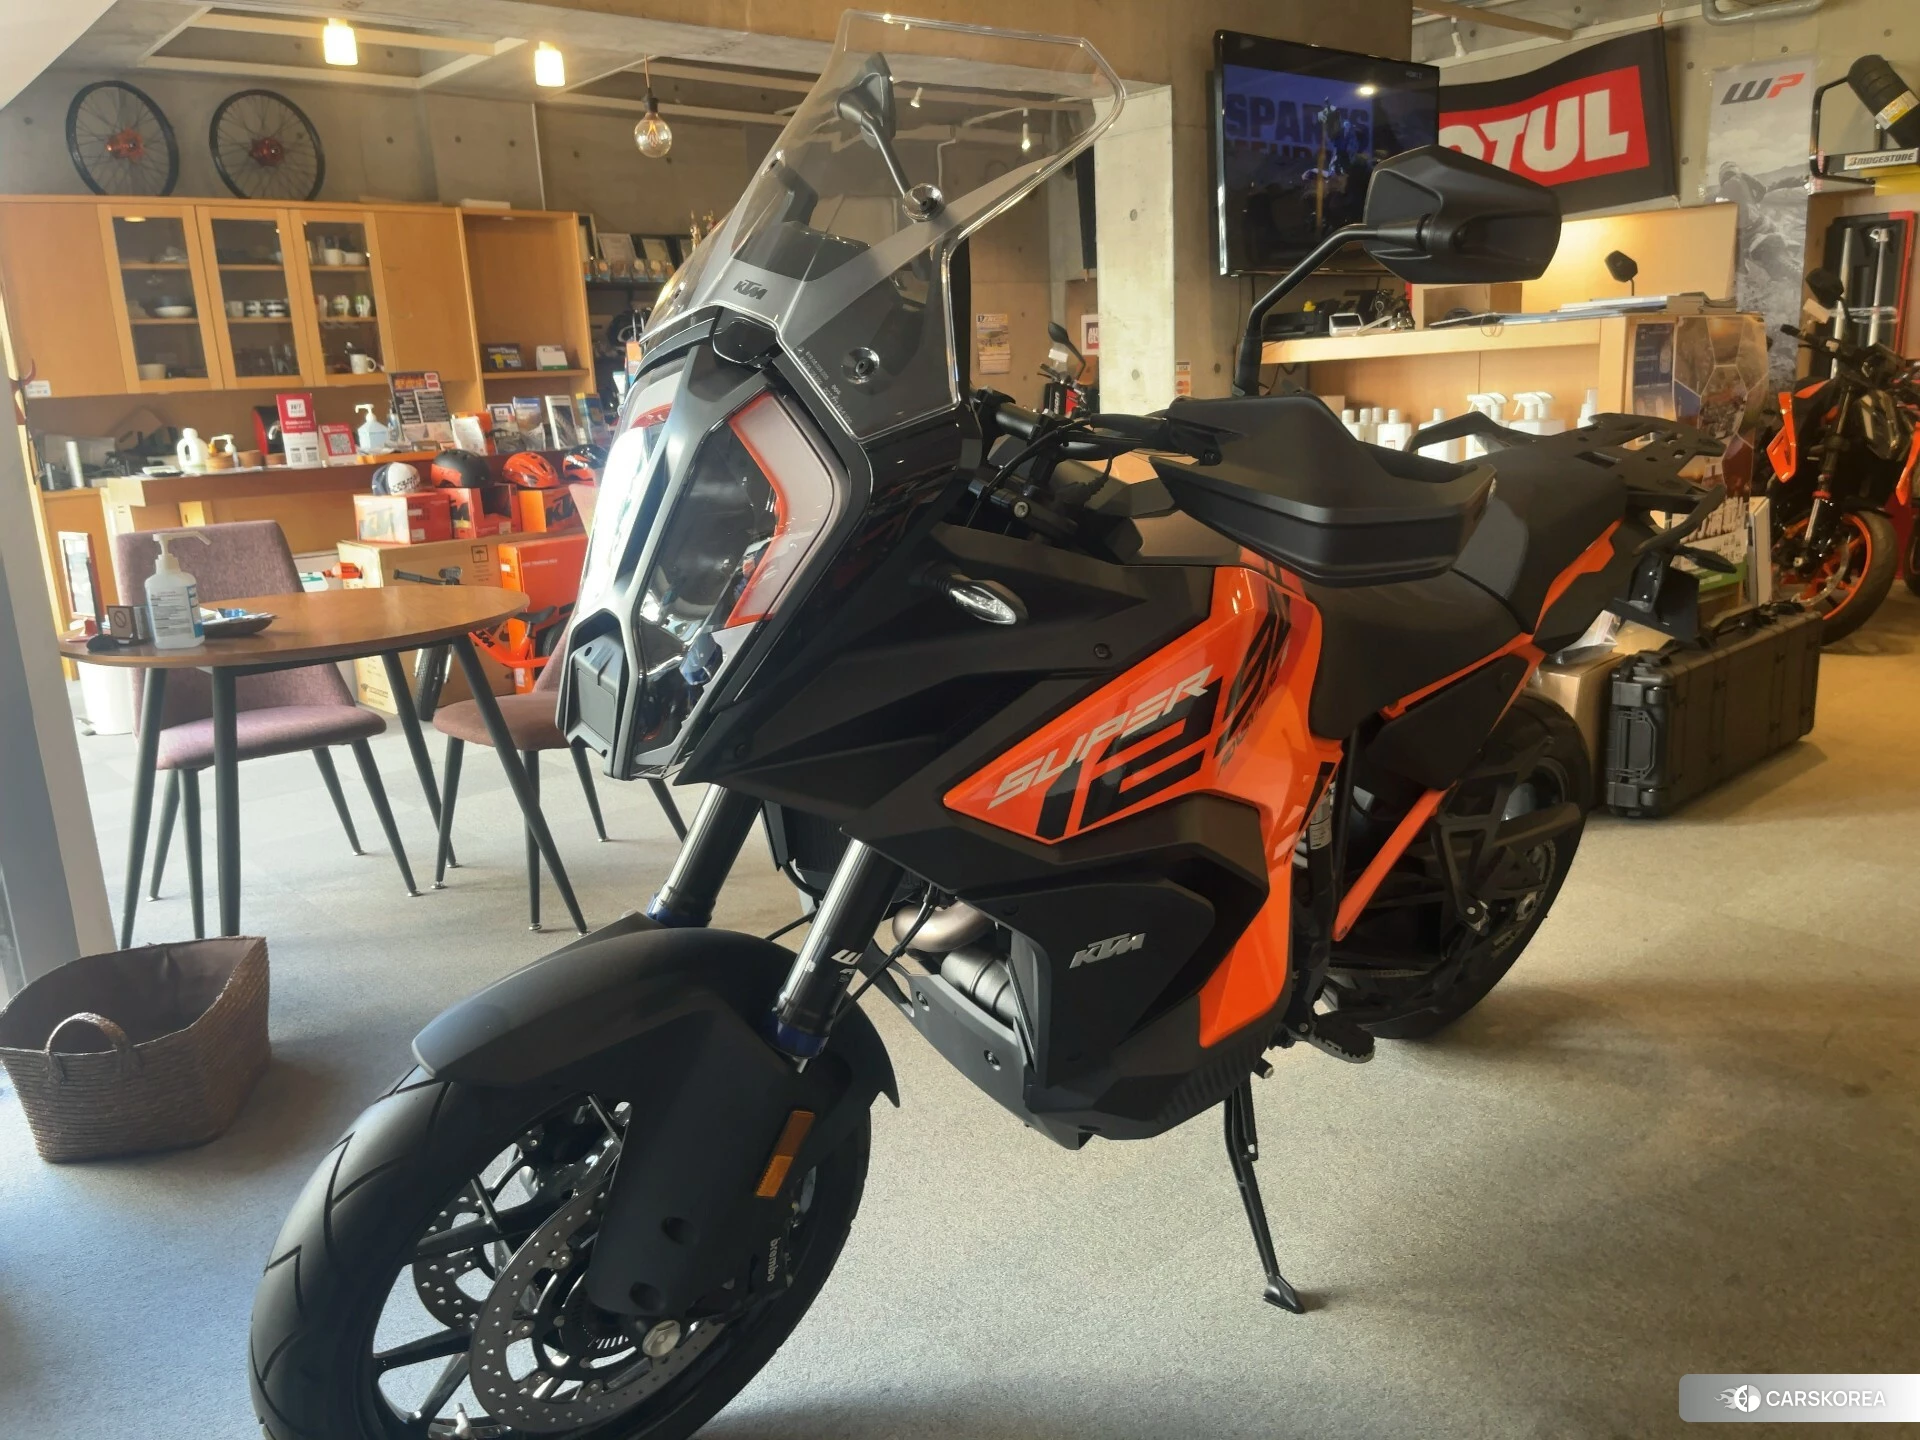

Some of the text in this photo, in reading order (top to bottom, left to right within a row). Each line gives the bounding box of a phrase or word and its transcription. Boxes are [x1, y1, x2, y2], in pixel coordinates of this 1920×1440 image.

[1720, 73, 1805, 105] WP
[1225, 93, 1369, 149] SPARS
[1848, 152, 1914, 166] BRIDGESTONE
[733, 280, 768, 300] KTM
[988, 664, 1213, 810] SUPER
[1068, 932, 1146, 969] KTM
[767, 1237, 781, 1282] brembo
